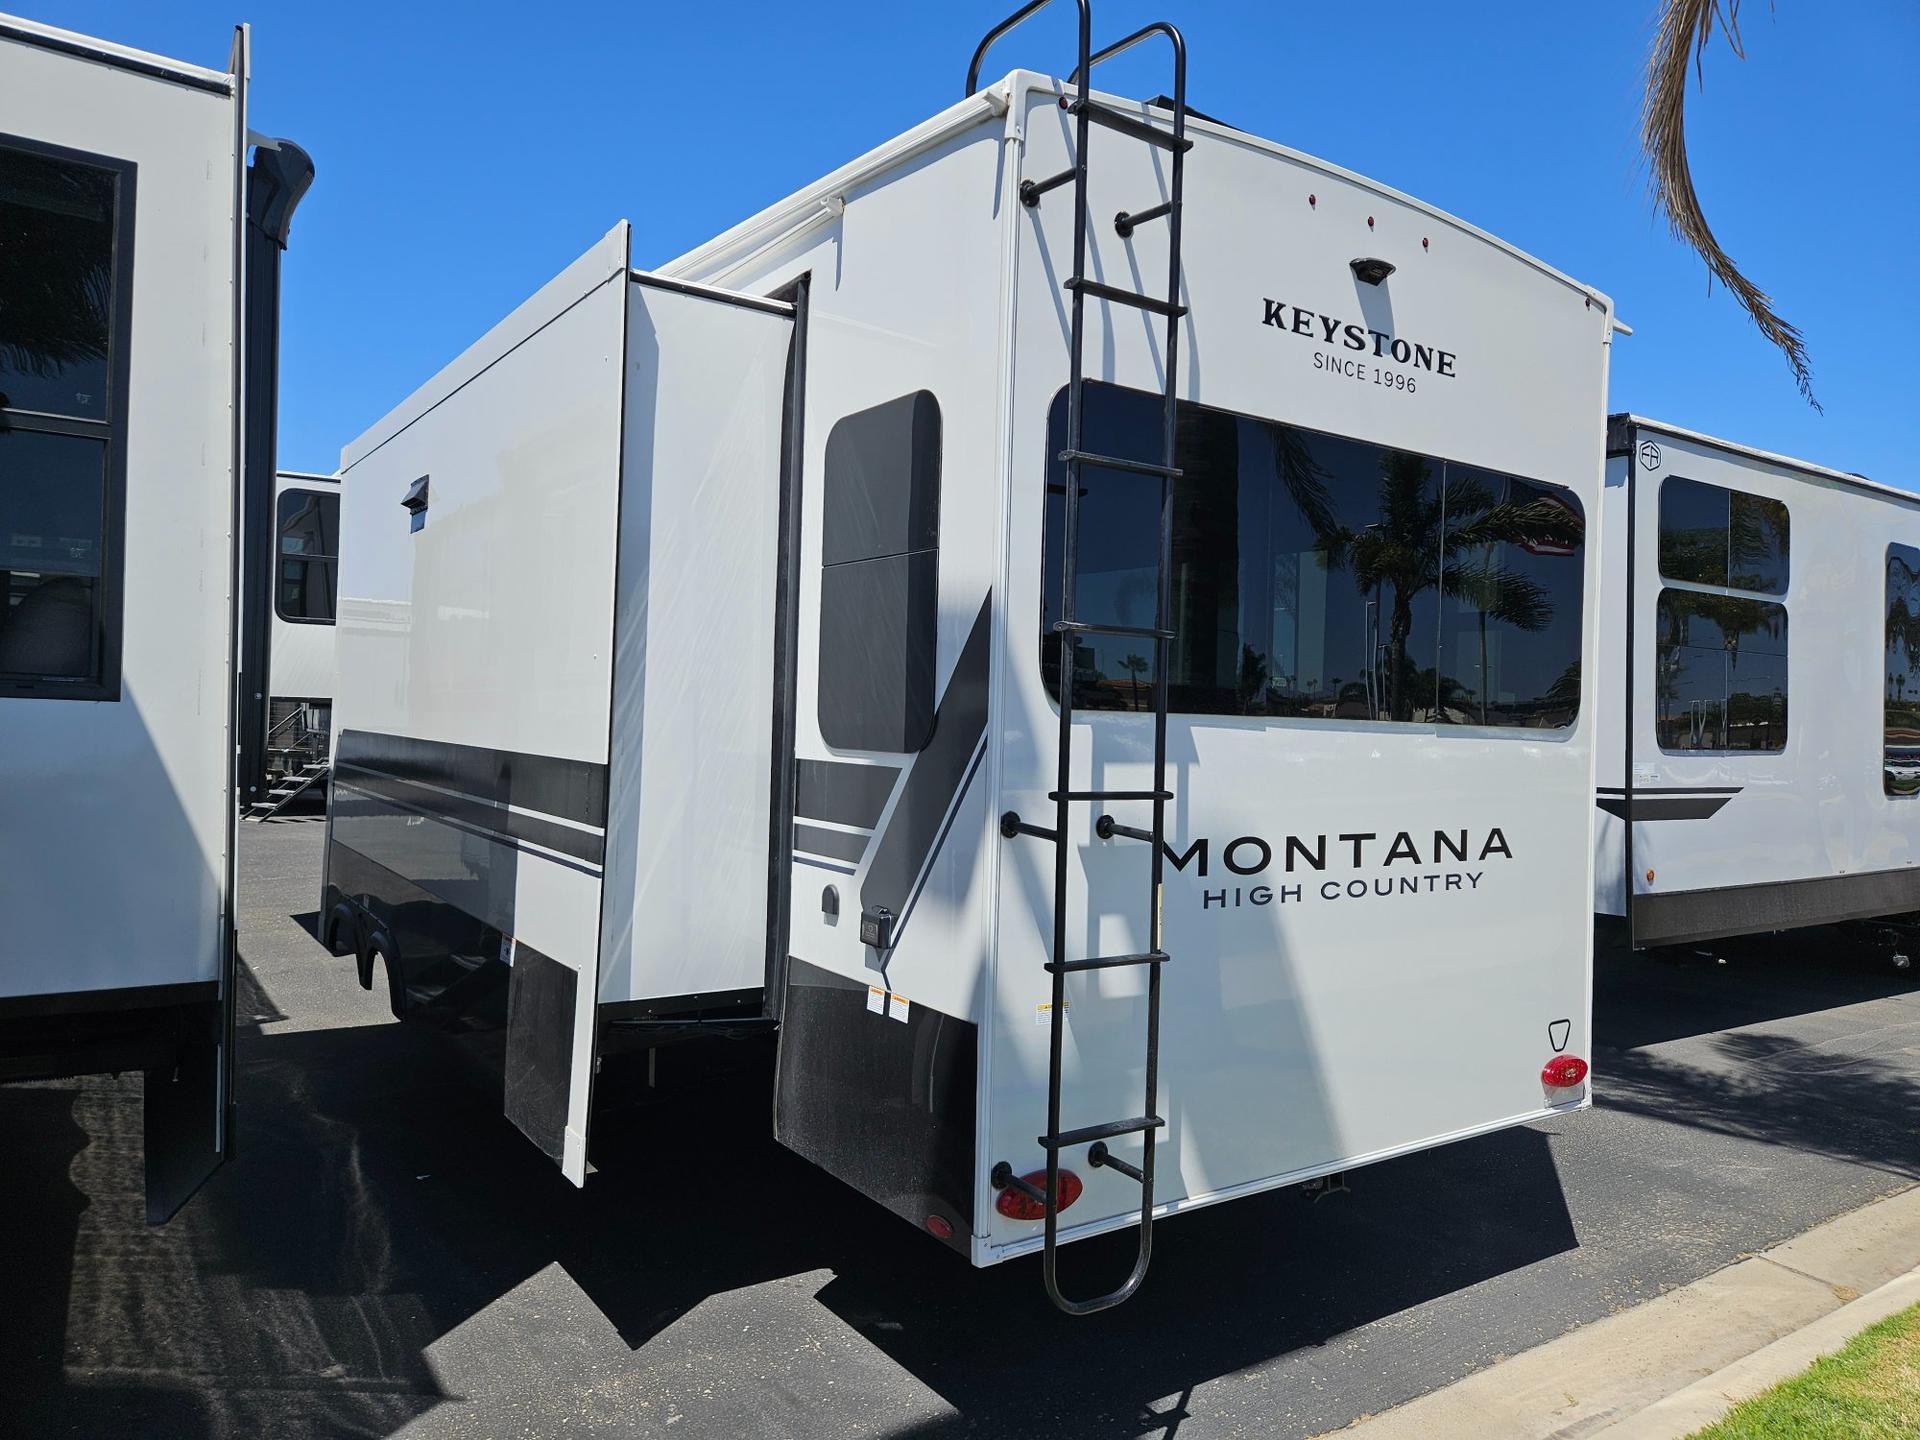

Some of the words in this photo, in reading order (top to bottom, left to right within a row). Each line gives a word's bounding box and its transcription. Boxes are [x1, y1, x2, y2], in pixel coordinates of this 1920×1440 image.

[1262, 297, 1457, 378] KEYSTONE
[1313, 351, 1366, 381] SINCE
[1373, 368, 1417, 394] 1996
[1161, 827, 1513, 877] MONTANA
[1203, 883, 1303, 910] HIGH
[1320, 871, 1484, 901] COUNTRY
